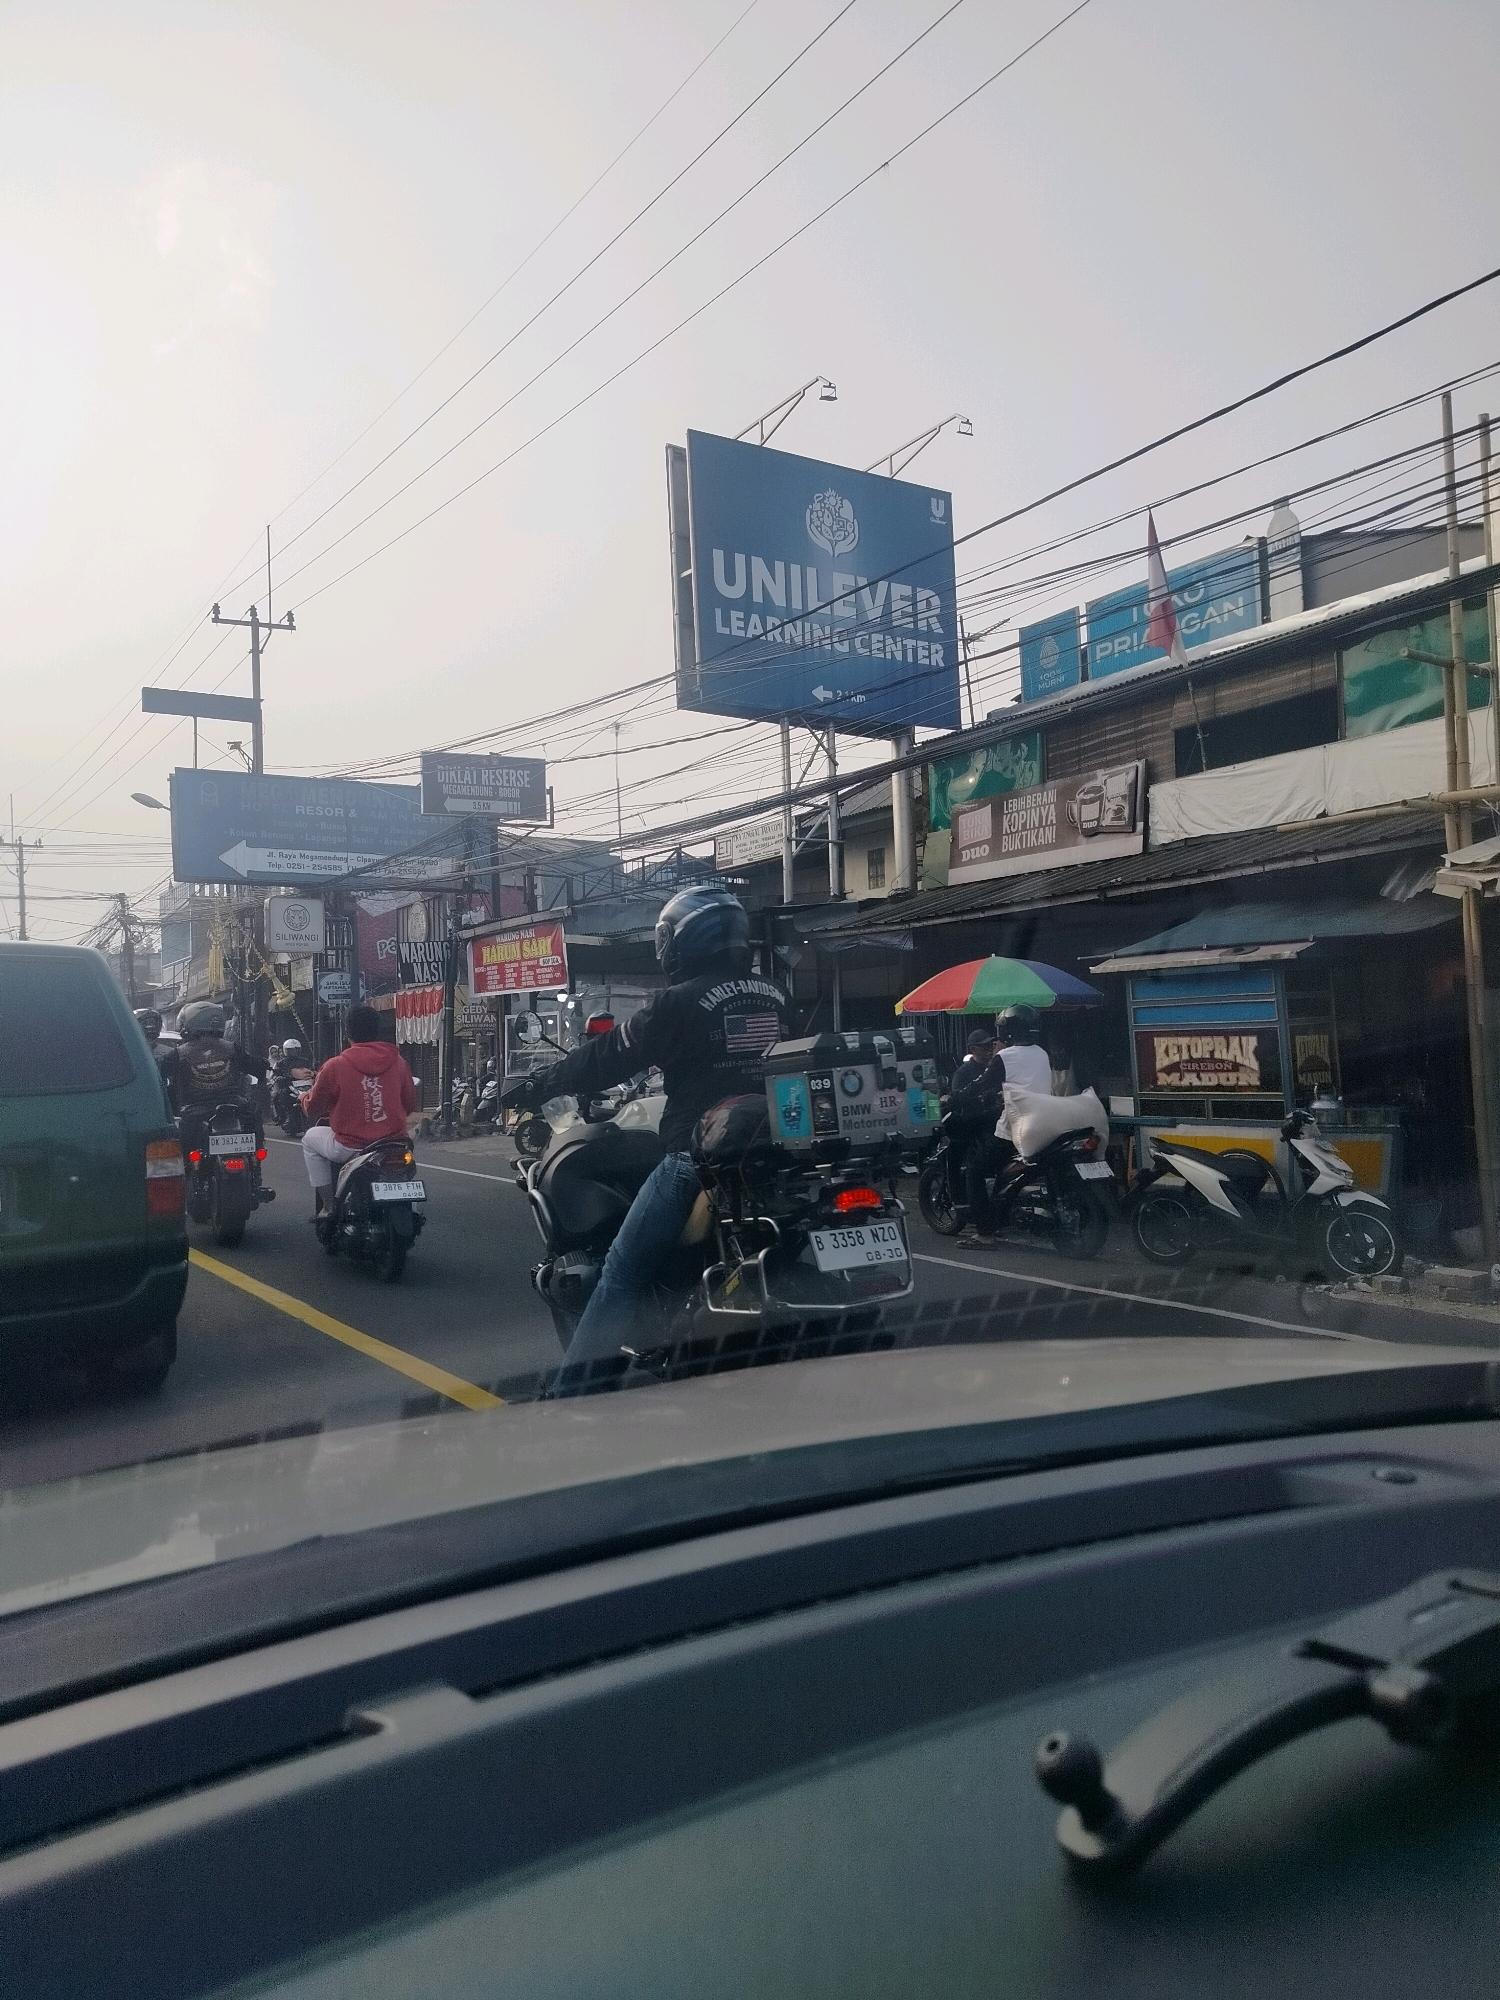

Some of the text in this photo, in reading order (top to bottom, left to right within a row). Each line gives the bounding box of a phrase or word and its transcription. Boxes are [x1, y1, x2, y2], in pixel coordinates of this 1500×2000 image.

[712, 548, 944, 634] UNILEVER
[714, 607, 945, 667] LEARNING CENTER
[1038, 675, 1065, 690] MURNI
[437, 765, 531, 788] DIKLAT RESERSE
[442, 784, 493, 798] MEGAMENDUNG
[499, 787, 521, 799] BOGOR
[1003, 788, 1057, 814] LEBIH BERANI
[295, 805, 345, 817] RESOR
[348, 808, 358, 818] &
[1002, 803, 1056, 835] KOPINYA
[961, 813, 989, 841] TORA BIKA
[1083, 820, 1098, 829] DUO
[229, 828, 258, 839] Kolam
[261, 830, 295, 842] Renang
[305, 833, 347, 845] Lapangan
[1002, 825, 1057, 853] BUKTIKAN!
[279, 851, 297, 861] Raya
[299, 853, 348, 863] Megamendung
[962, 844, 990, 862] DUO
[267, 861, 285, 871] Telp.
[275, 932, 319, 943] SILIWANGI
[496, 929, 537, 943] WARUNG NASI
[400, 941, 451, 963] WARUNG
[482, 936, 552, 965] HARUM SARI
[413, 962, 443, 982] NASI
[698, 979, 786, 1012] HARLEY-DAVIDSON
[462, 1005, 488, 1014] GEBY
[456, 1014, 497, 1024] SILIWAN
[1153, 1035, 1260, 1071] KETOPRAK
[1180, 1061, 1233, 1071] CIREBON
[810, 1078, 831, 1091] 039
[1157, 1072, 1260, 1087] MADUN
[879, 1095, 899, 1108] HR
[841, 1103, 872, 1117] BMW
[842, 1114, 898, 1131] Motorrad
[240, 1136, 254, 1145] AAA
[374, 1184, 380, 1192] B
[815, 1235, 825, 1251] B
[830, 1230, 866, 1249] 3358
